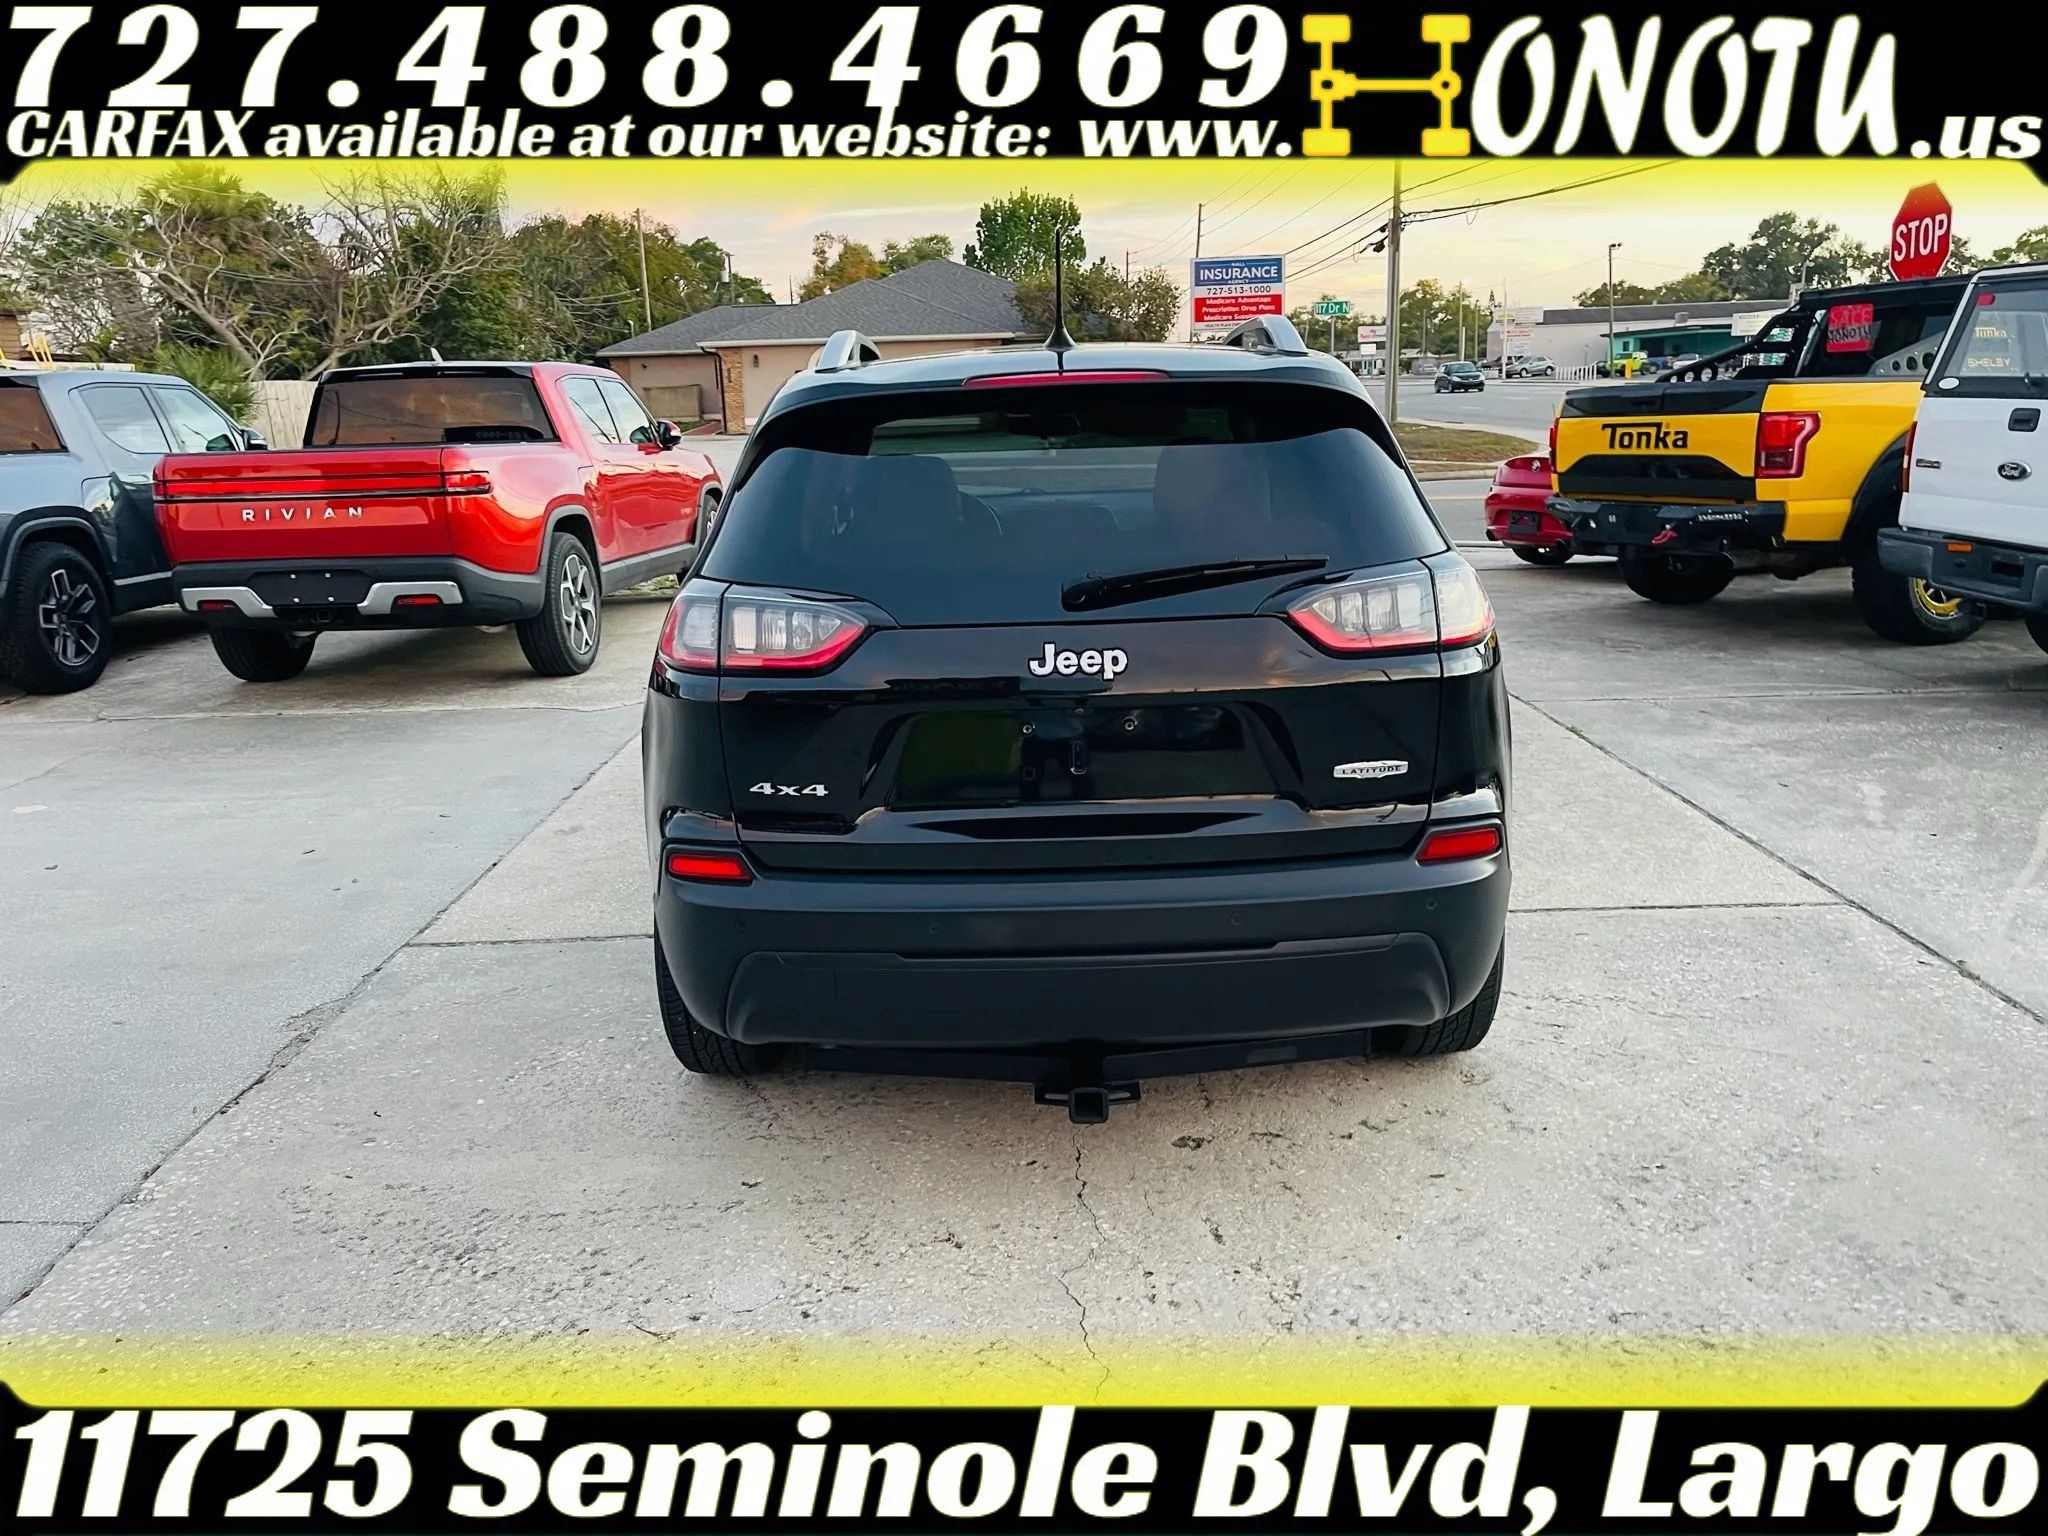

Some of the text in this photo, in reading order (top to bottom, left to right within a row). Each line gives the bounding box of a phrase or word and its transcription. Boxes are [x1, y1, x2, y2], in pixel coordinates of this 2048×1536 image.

[1894, 213, 1948, 262] STOP
[1200, 266, 1278, 280] INSURANCE
[1207, 285, 1271, 295] 727-513-1000
[1329, 302, 1341, 313] Dr
[1342, 302, 1350, 313] N
[1967, 358, 2010, 368] SHELBY
[1602, 422, 1688, 449] Tonka
[242, 506, 362, 522] RIVIAN
[1029, 643, 1128, 680] Jeep
[1342, 766, 1401, 775] LATITUDE
[749, 782, 829, 797] 4x4
